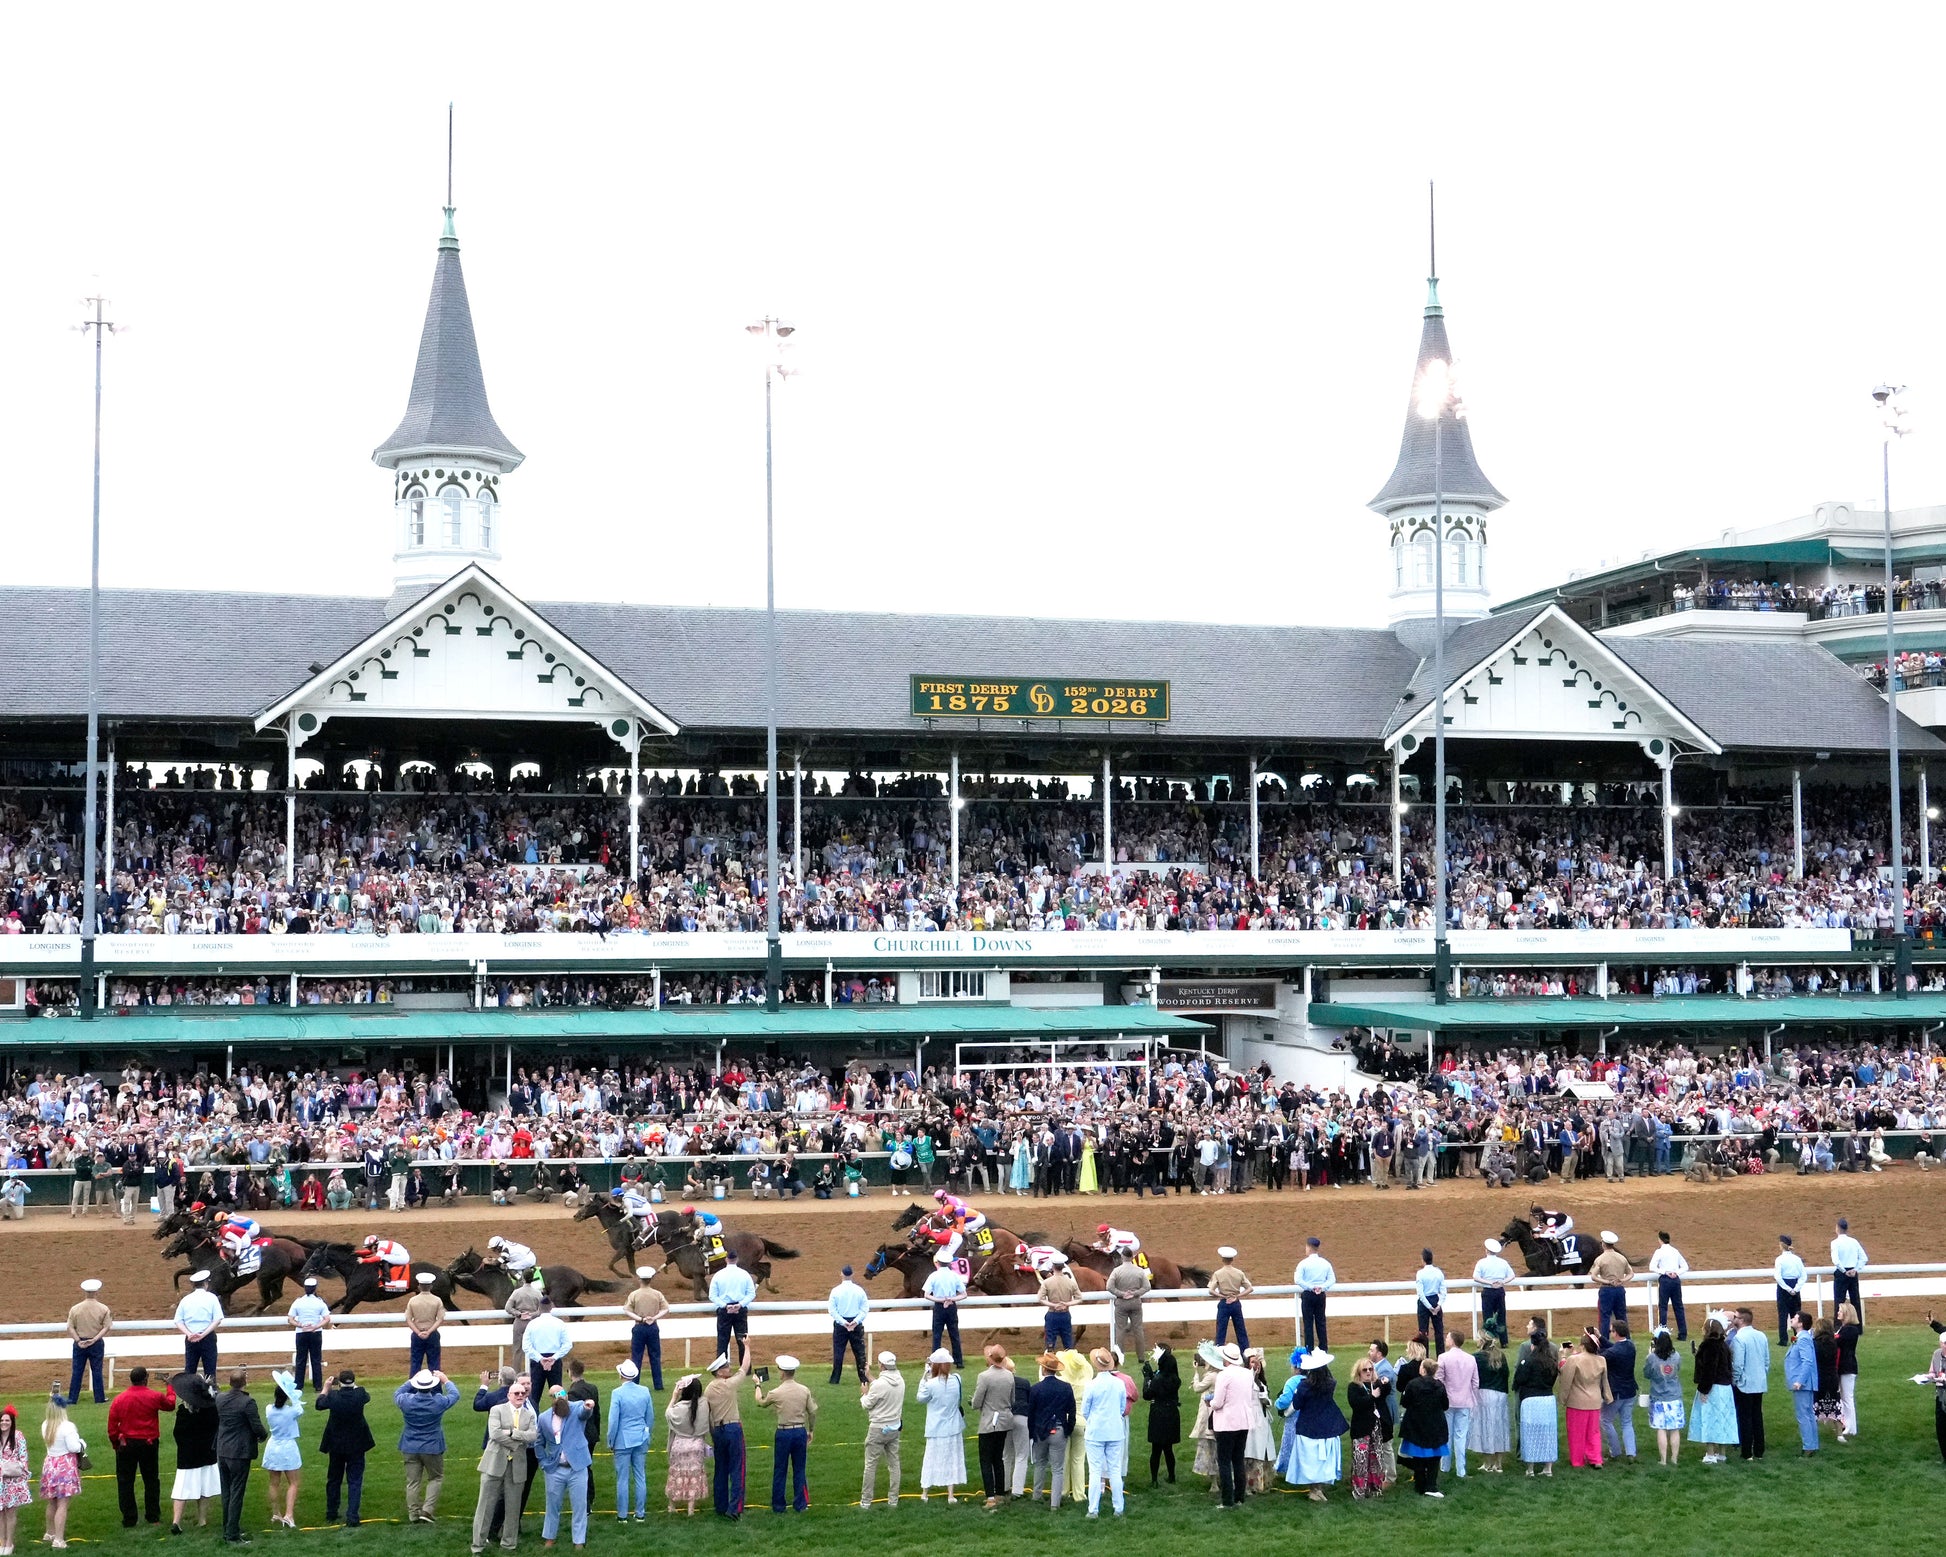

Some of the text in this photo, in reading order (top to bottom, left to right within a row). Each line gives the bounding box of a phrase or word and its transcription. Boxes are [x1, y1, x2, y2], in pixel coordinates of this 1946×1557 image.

[919, 683, 1019, 695] FIRST DERBY
[1064, 686, 1158, 698] 152ND DERBY
[930, 695, 1010, 712] 1875
[1071, 698, 1147, 715] 2026
[873, 936, 1032, 952] CHURCHILL DOWNS
[1178, 987, 1240, 996] KENTUCKY DERBY
[1157, 997, 1259, 1006] WOODFORD RESERVE
[976, 1227, 993, 1245] 18
[1561, 1235, 1576, 1254] 17
[957, 1259, 968, 1275] 8
